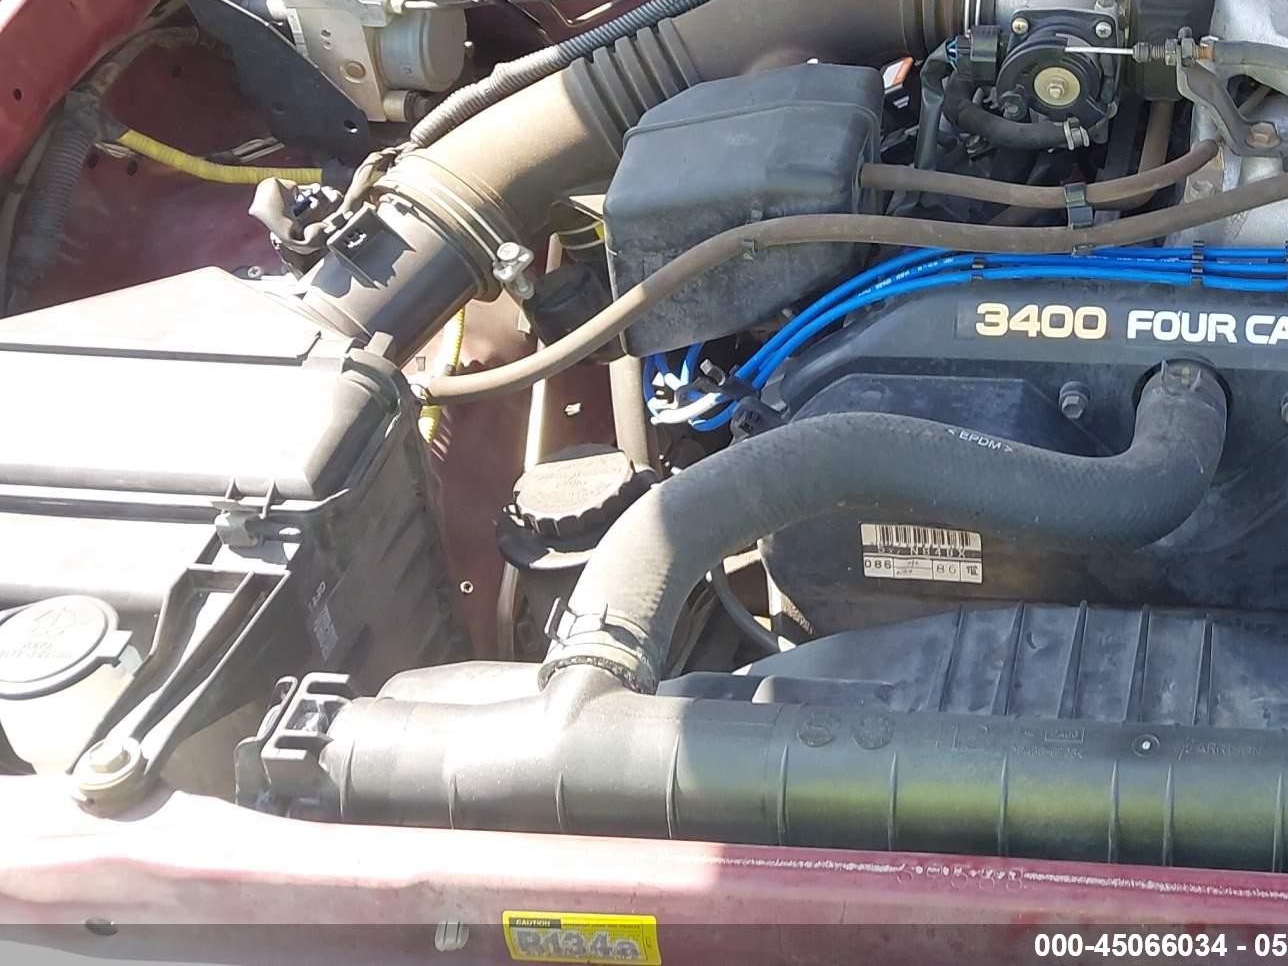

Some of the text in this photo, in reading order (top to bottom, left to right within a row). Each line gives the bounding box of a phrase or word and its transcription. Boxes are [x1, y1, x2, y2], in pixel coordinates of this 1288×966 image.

[975, 302, 1107, 340] 3400
[1127, 309, 1237, 344] FOUR
[959, 430, 1002, 450] EPDM
[515, 930, 642, 958] R134a
